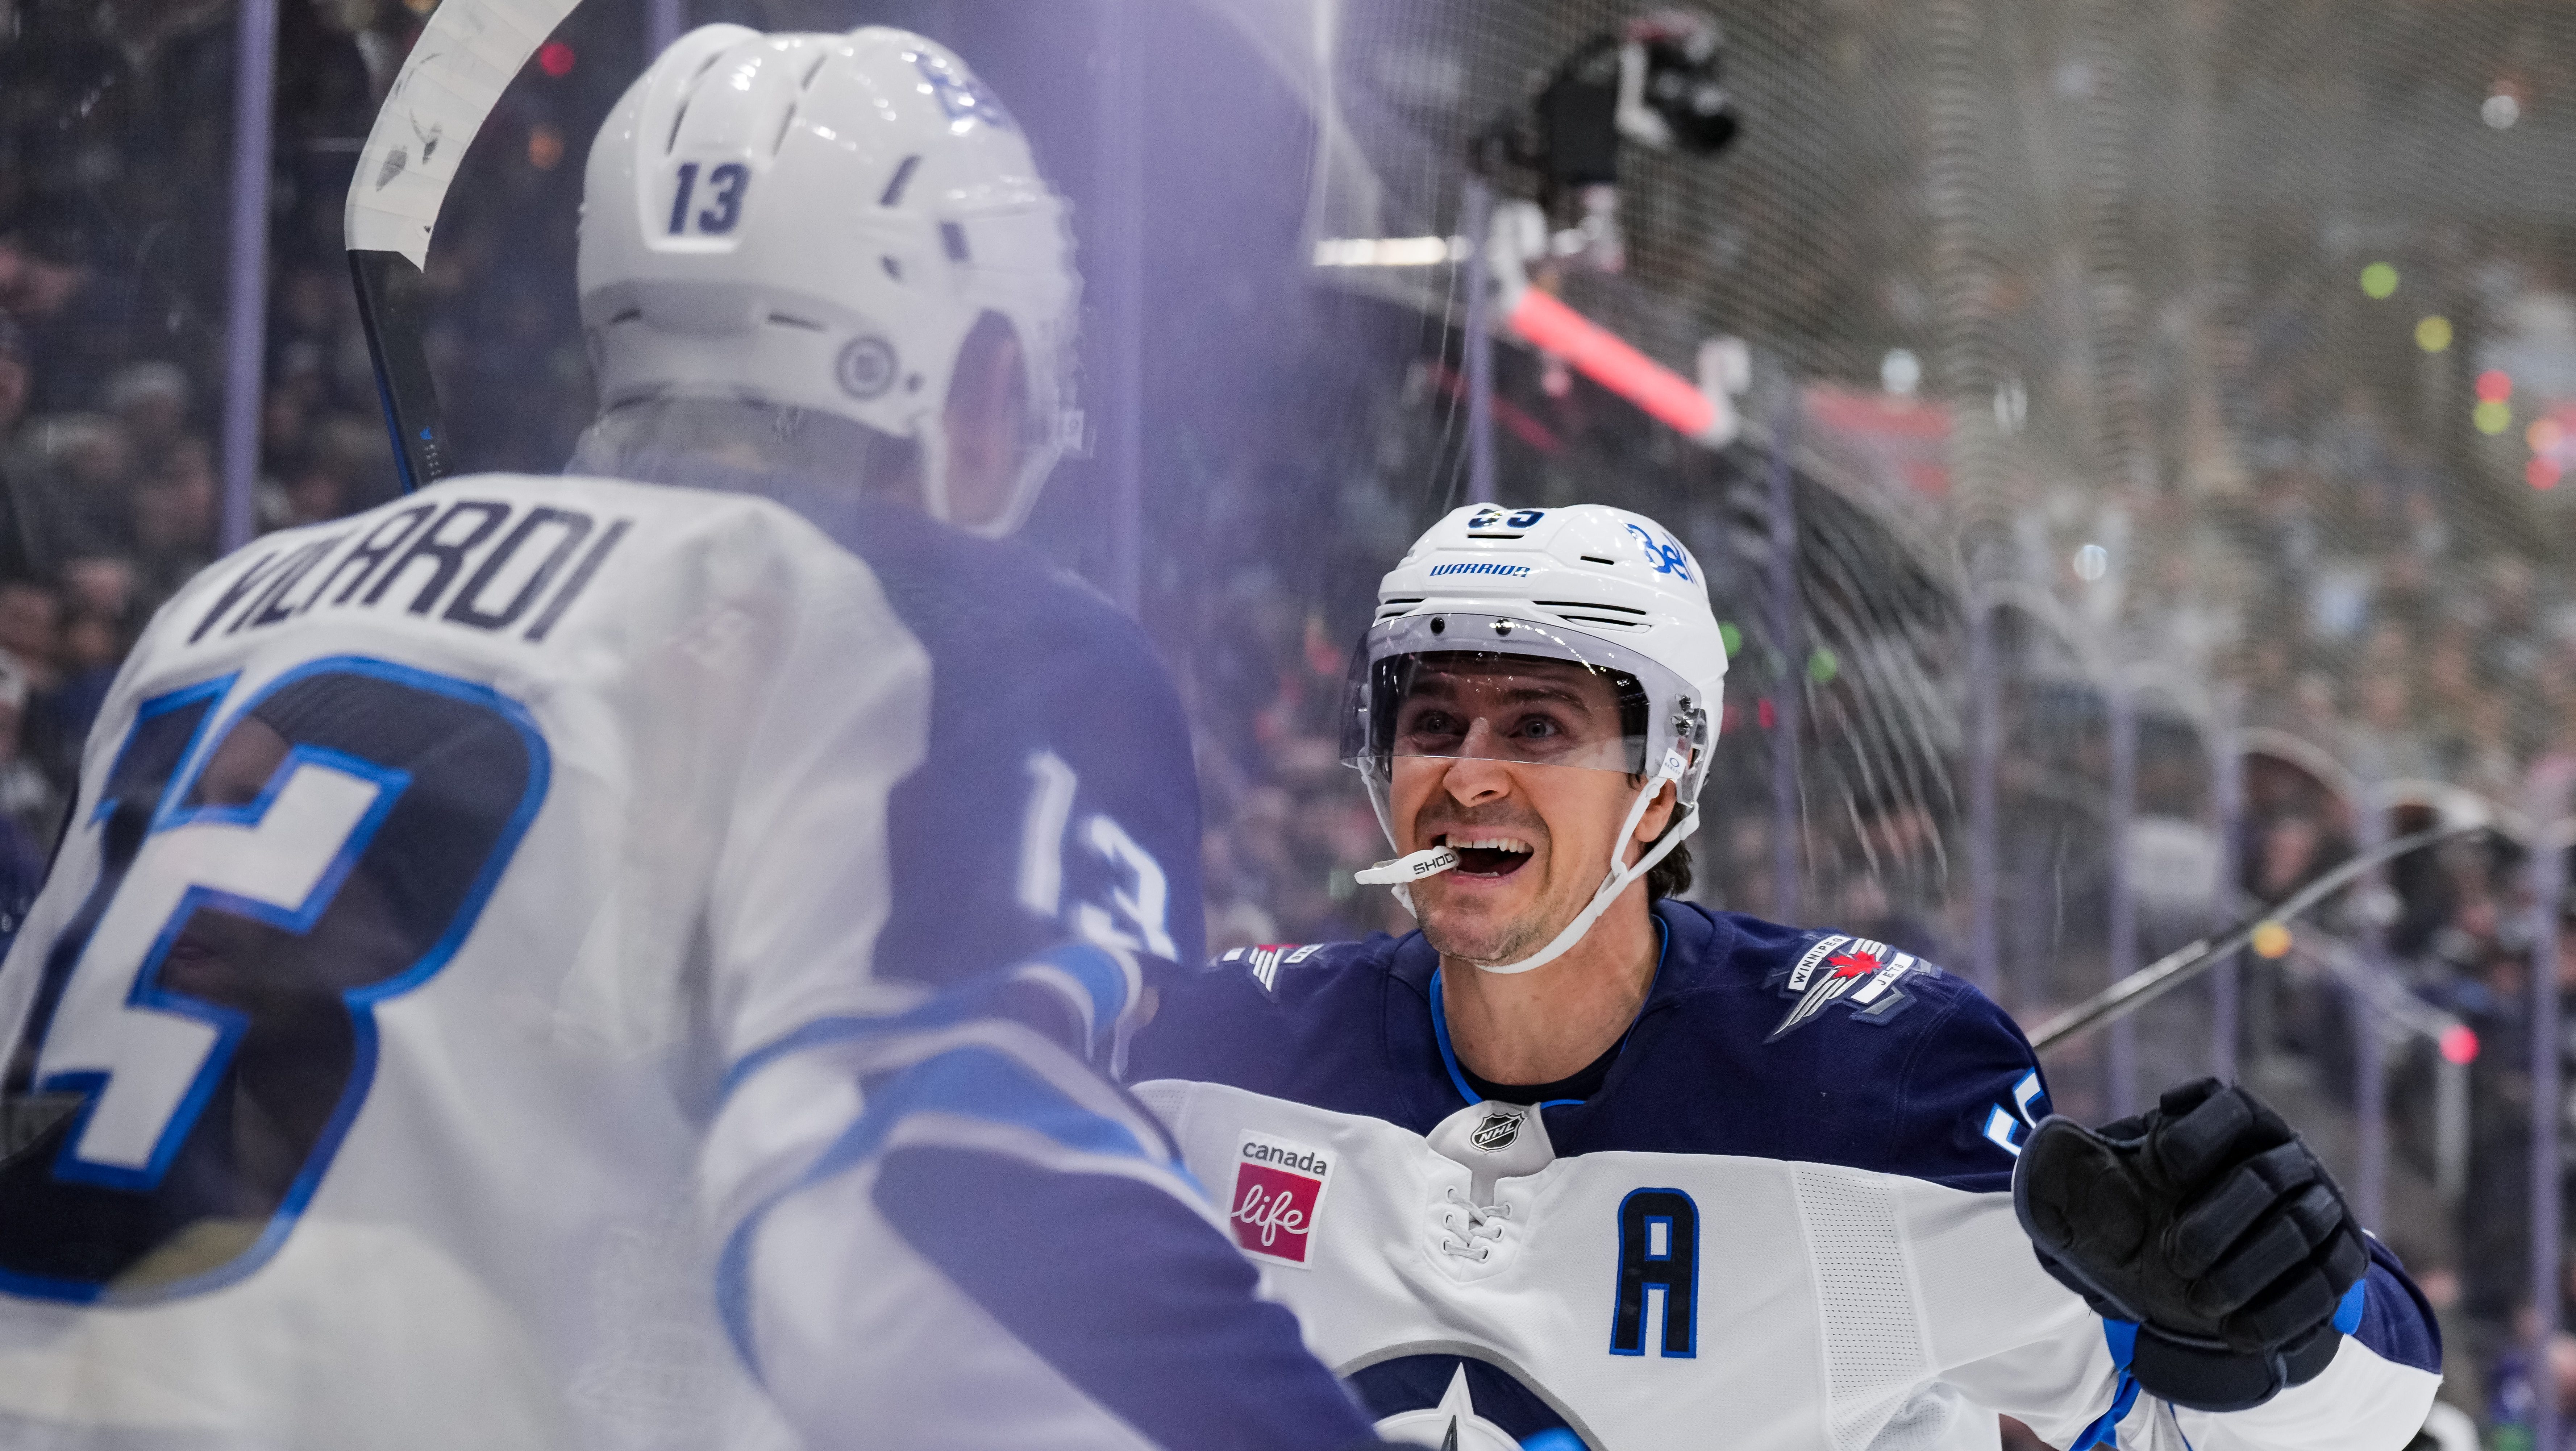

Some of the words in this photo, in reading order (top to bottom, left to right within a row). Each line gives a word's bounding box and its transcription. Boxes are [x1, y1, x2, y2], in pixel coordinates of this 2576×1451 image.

[667, 161, 752, 236] 13
[187, 499, 636, 646] VILARDI
[1429, 562, 1531, 578] WARRIOR
[1020, 748, 1183, 965] 13
[0, 652, 552, 1315] 13
[1794, 938, 1843, 983] WINNIPEG
[1877, 964, 1904, 986] JETS
[1243, 1142, 1327, 1176] canada
[1478, 1122, 1514, 1143] NHL
[1231, 1184, 1309, 1247] life
[1609, 1187, 1700, 1359] A
